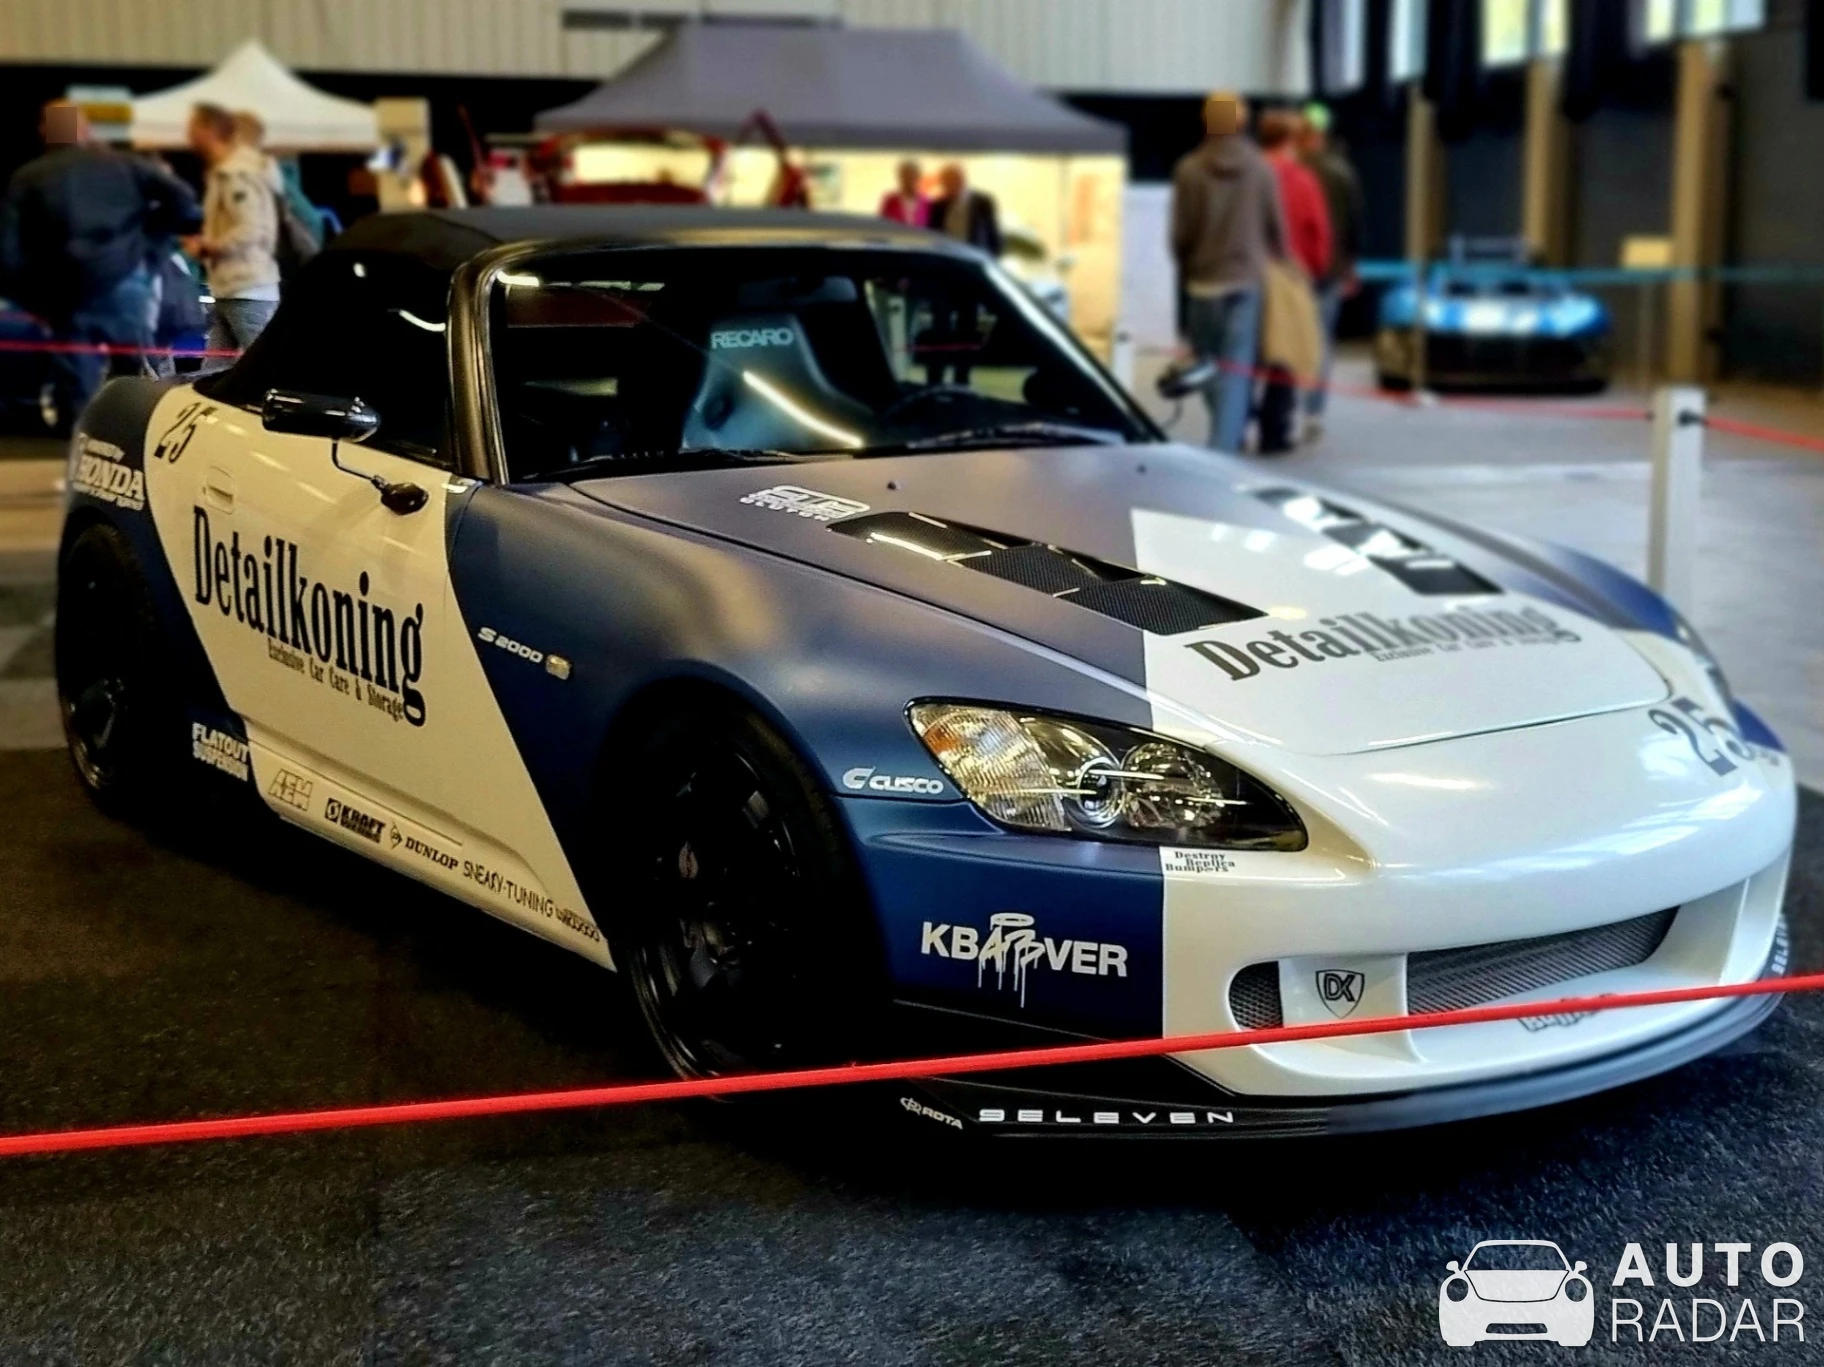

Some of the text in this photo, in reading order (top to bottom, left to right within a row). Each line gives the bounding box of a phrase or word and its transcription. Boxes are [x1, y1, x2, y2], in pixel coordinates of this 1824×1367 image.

[711, 328, 794, 349] RECARO
[154, 402, 217, 464] 25
[194, 505, 426, 727] Detailkoning
[1184, 606, 1581, 681] Detailkoning
[192, 721, 249, 763] FLATOUT
[1648, 697, 1756, 777] 25
[405, 836, 459, 870] DUNLOP
[1174, 851, 1226, 861] Destroy
[1324, 973, 1355, 1002] DK
[921, 1106, 963, 1130] ROTA
